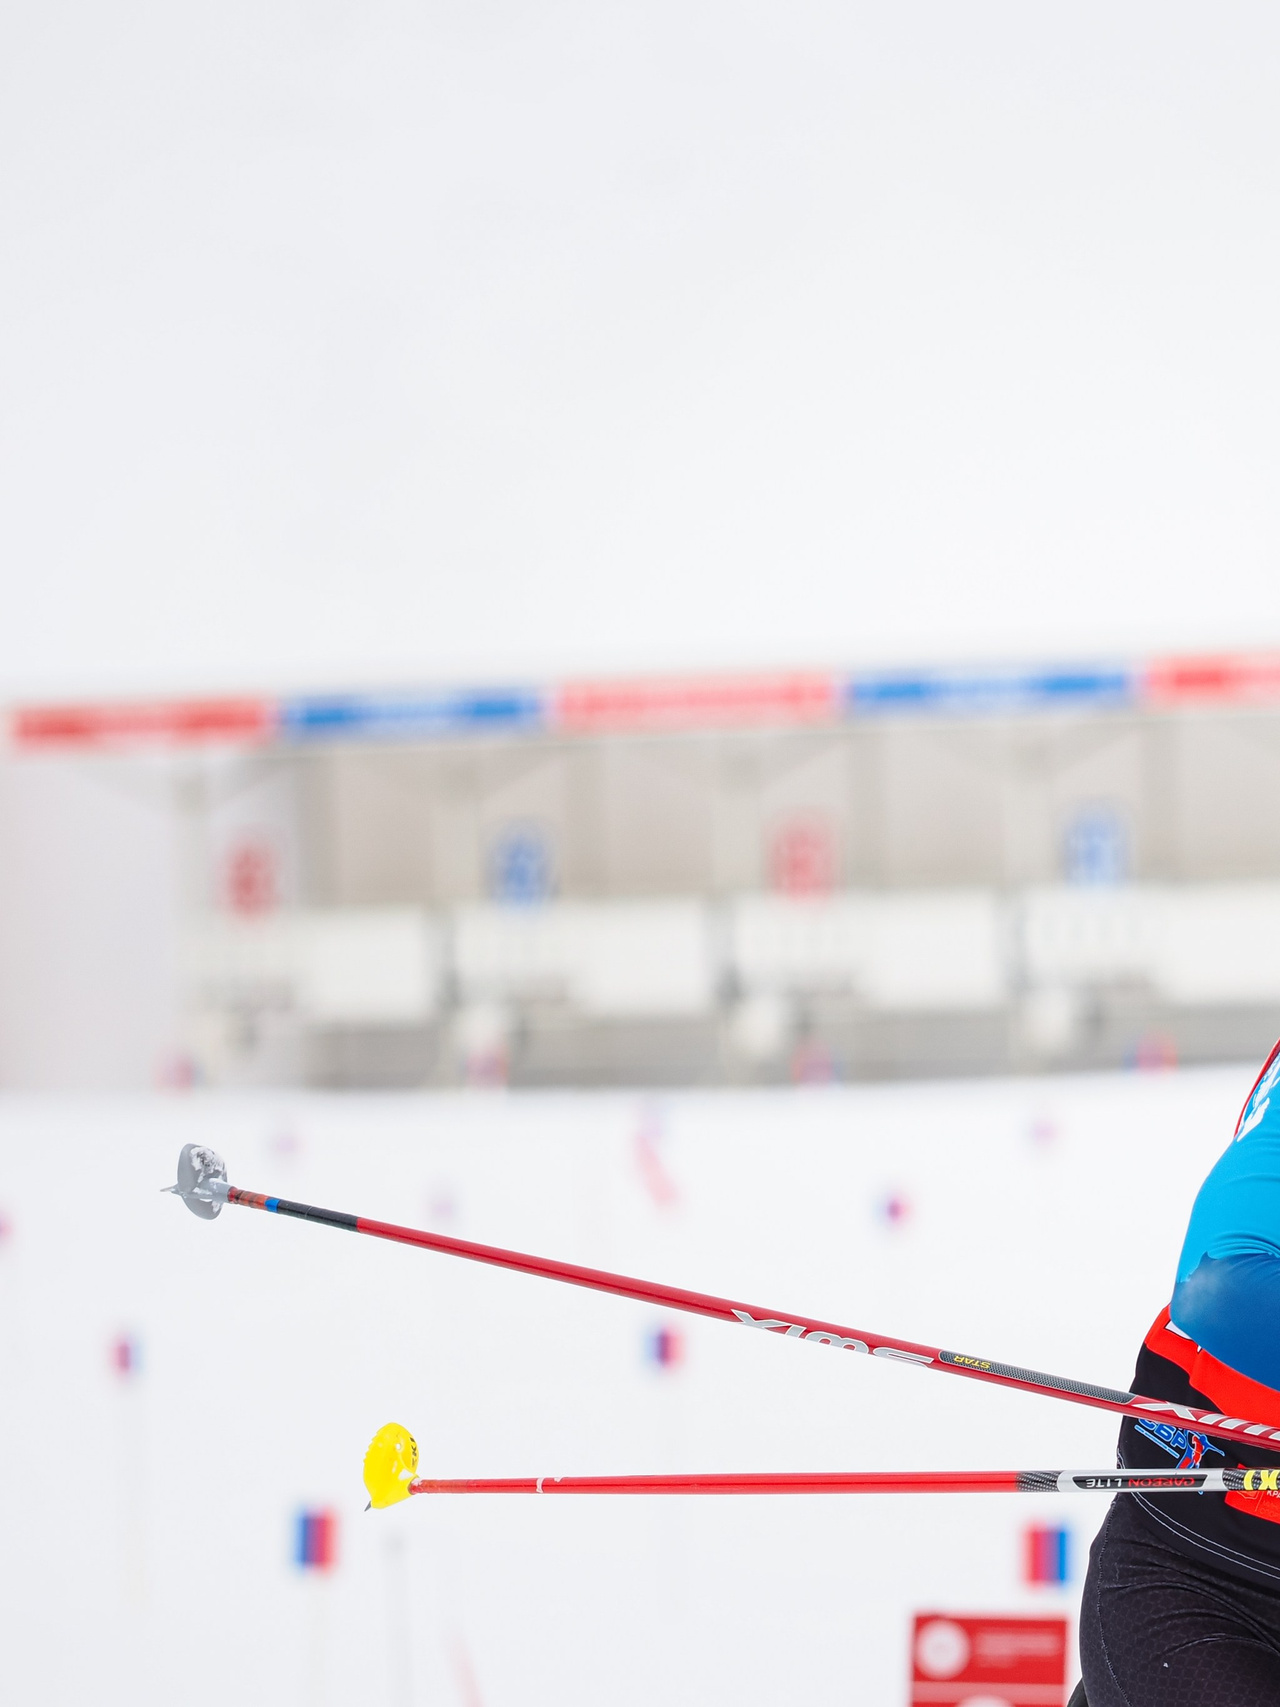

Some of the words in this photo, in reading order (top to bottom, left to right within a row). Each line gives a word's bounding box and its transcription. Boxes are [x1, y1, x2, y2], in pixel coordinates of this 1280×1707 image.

[953, 1355, 991, 1369] STAR
[1139, 1418, 1187, 1449] СБР
[1086, 1478, 1122, 1488] LITE
[1128, 1477, 1195, 1488] CARBON
